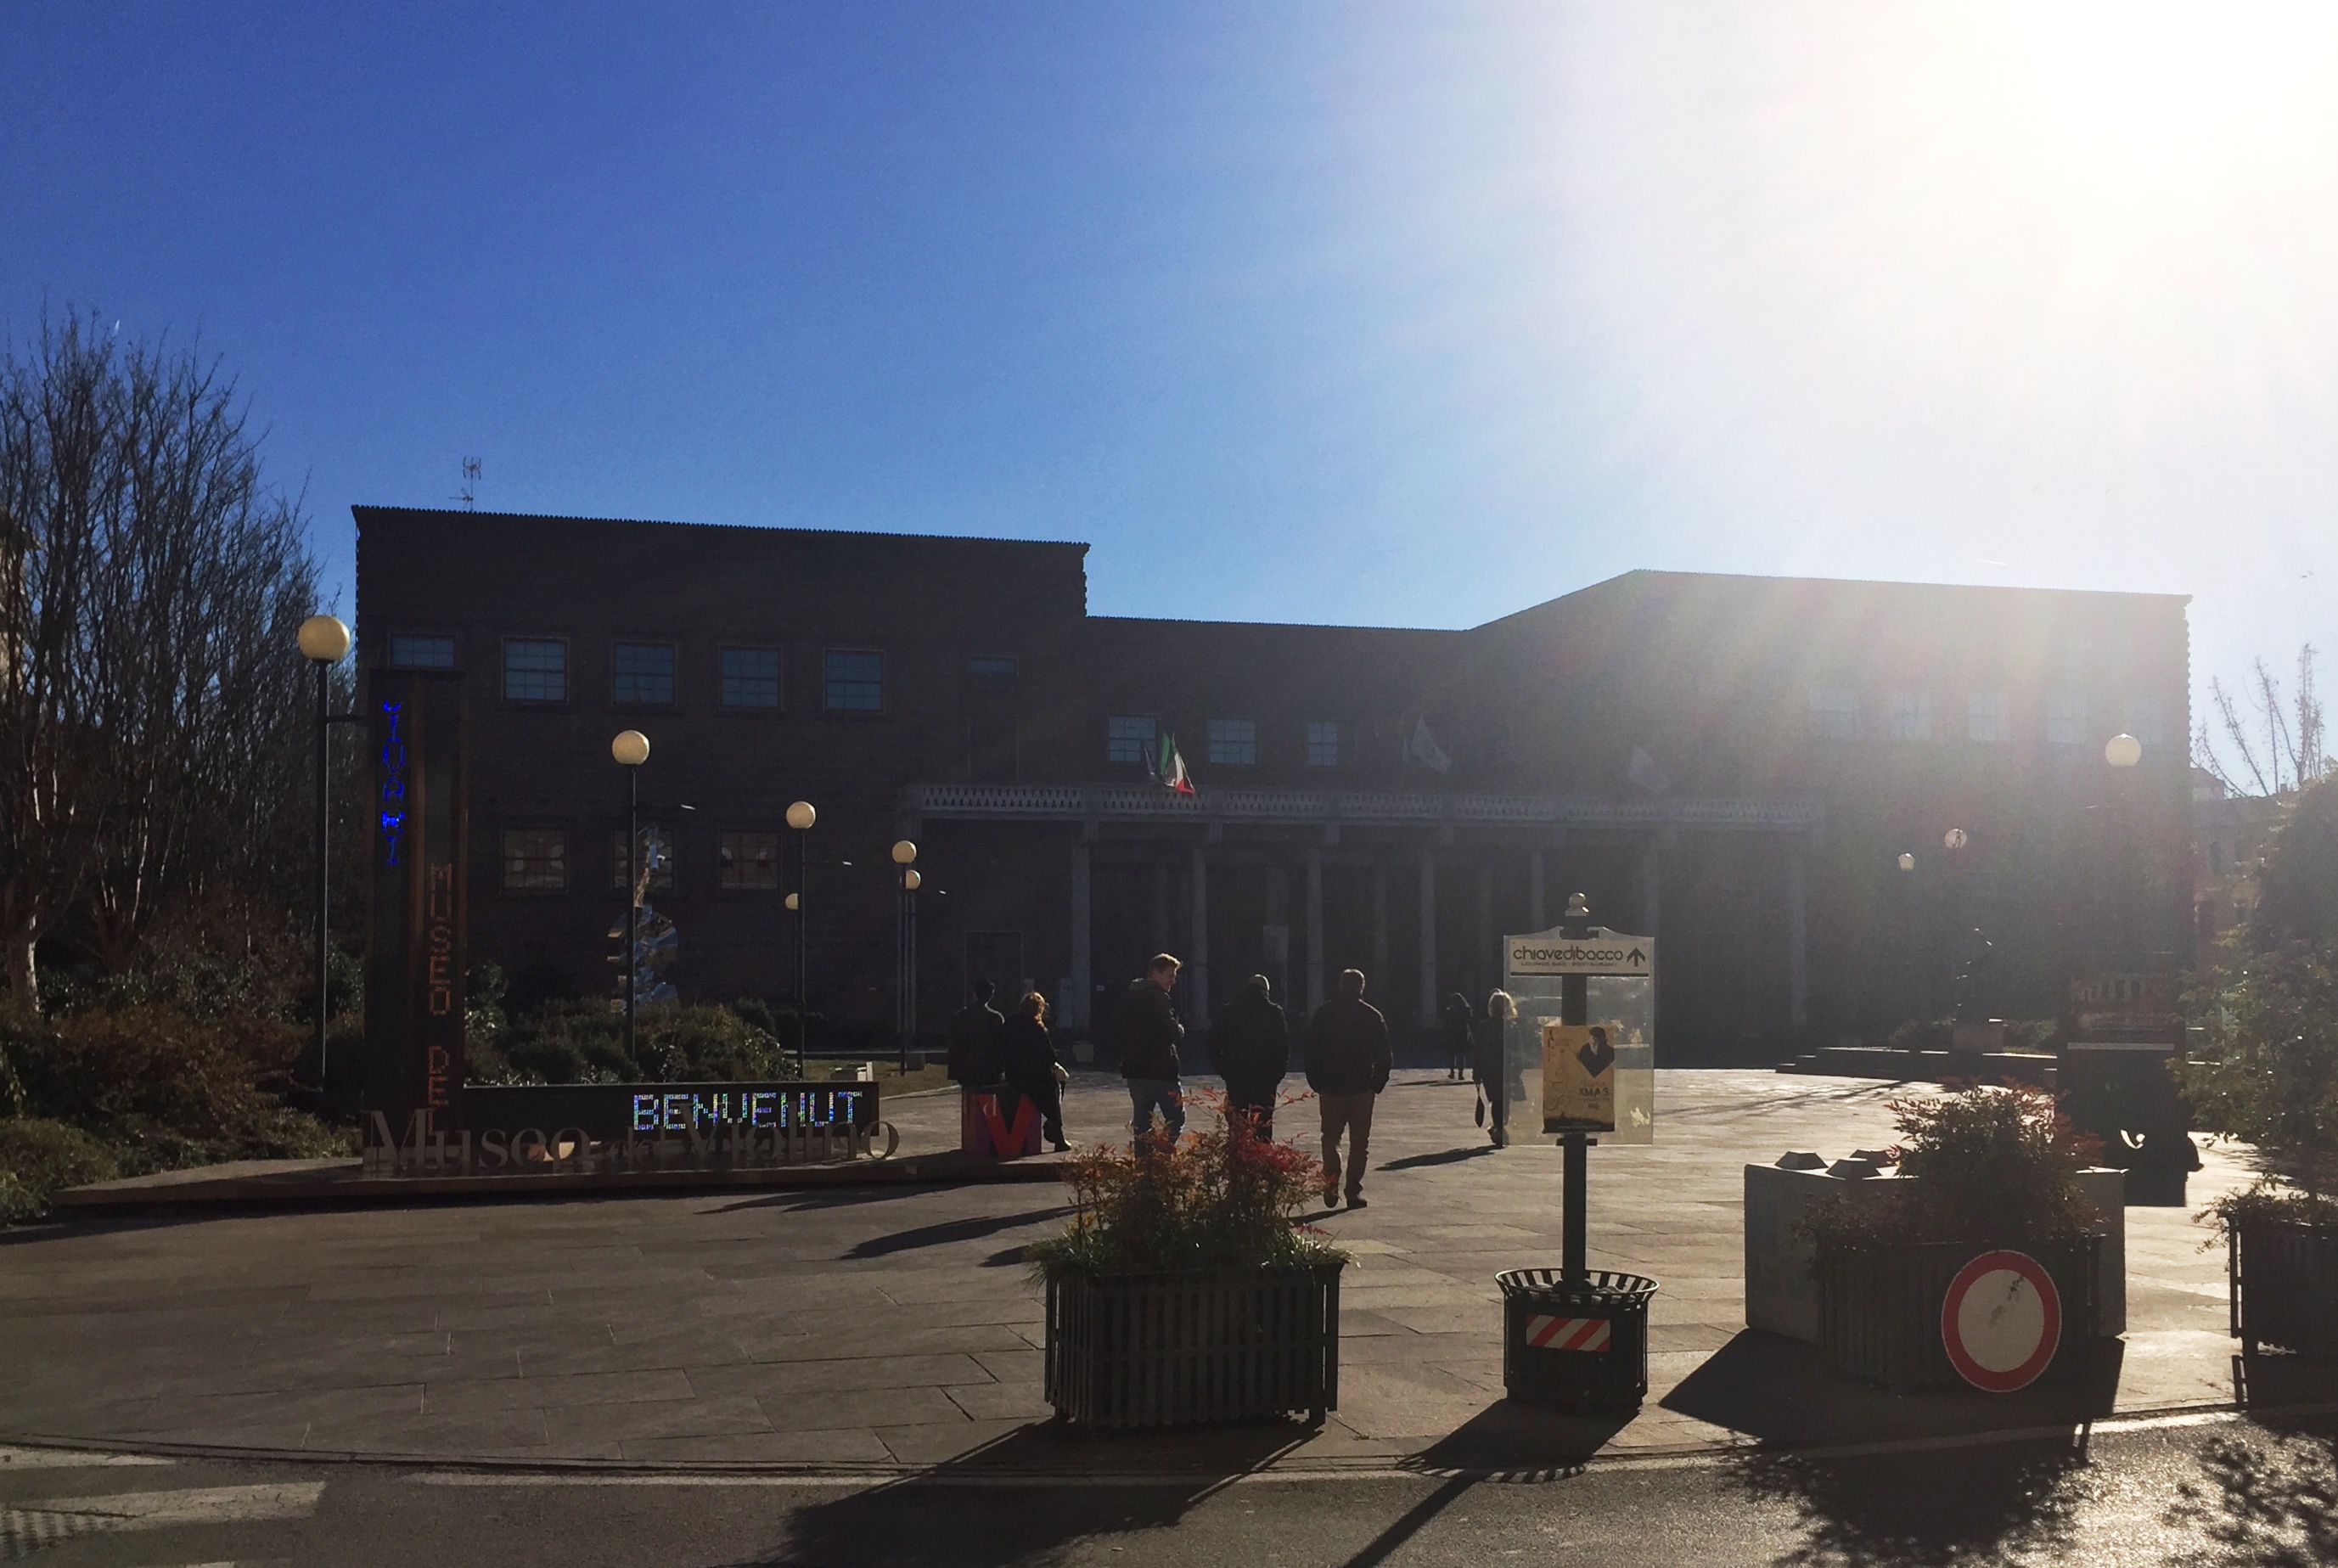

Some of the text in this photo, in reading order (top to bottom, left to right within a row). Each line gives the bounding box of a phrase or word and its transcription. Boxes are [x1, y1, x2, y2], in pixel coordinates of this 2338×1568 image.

[430, 863, 452, 1016] MUSEO
[1513, 945, 1623, 960] chiavedibacco
[360, 1108, 592, 1170] Museo
[670, 1101, 900, 1164] Violino
